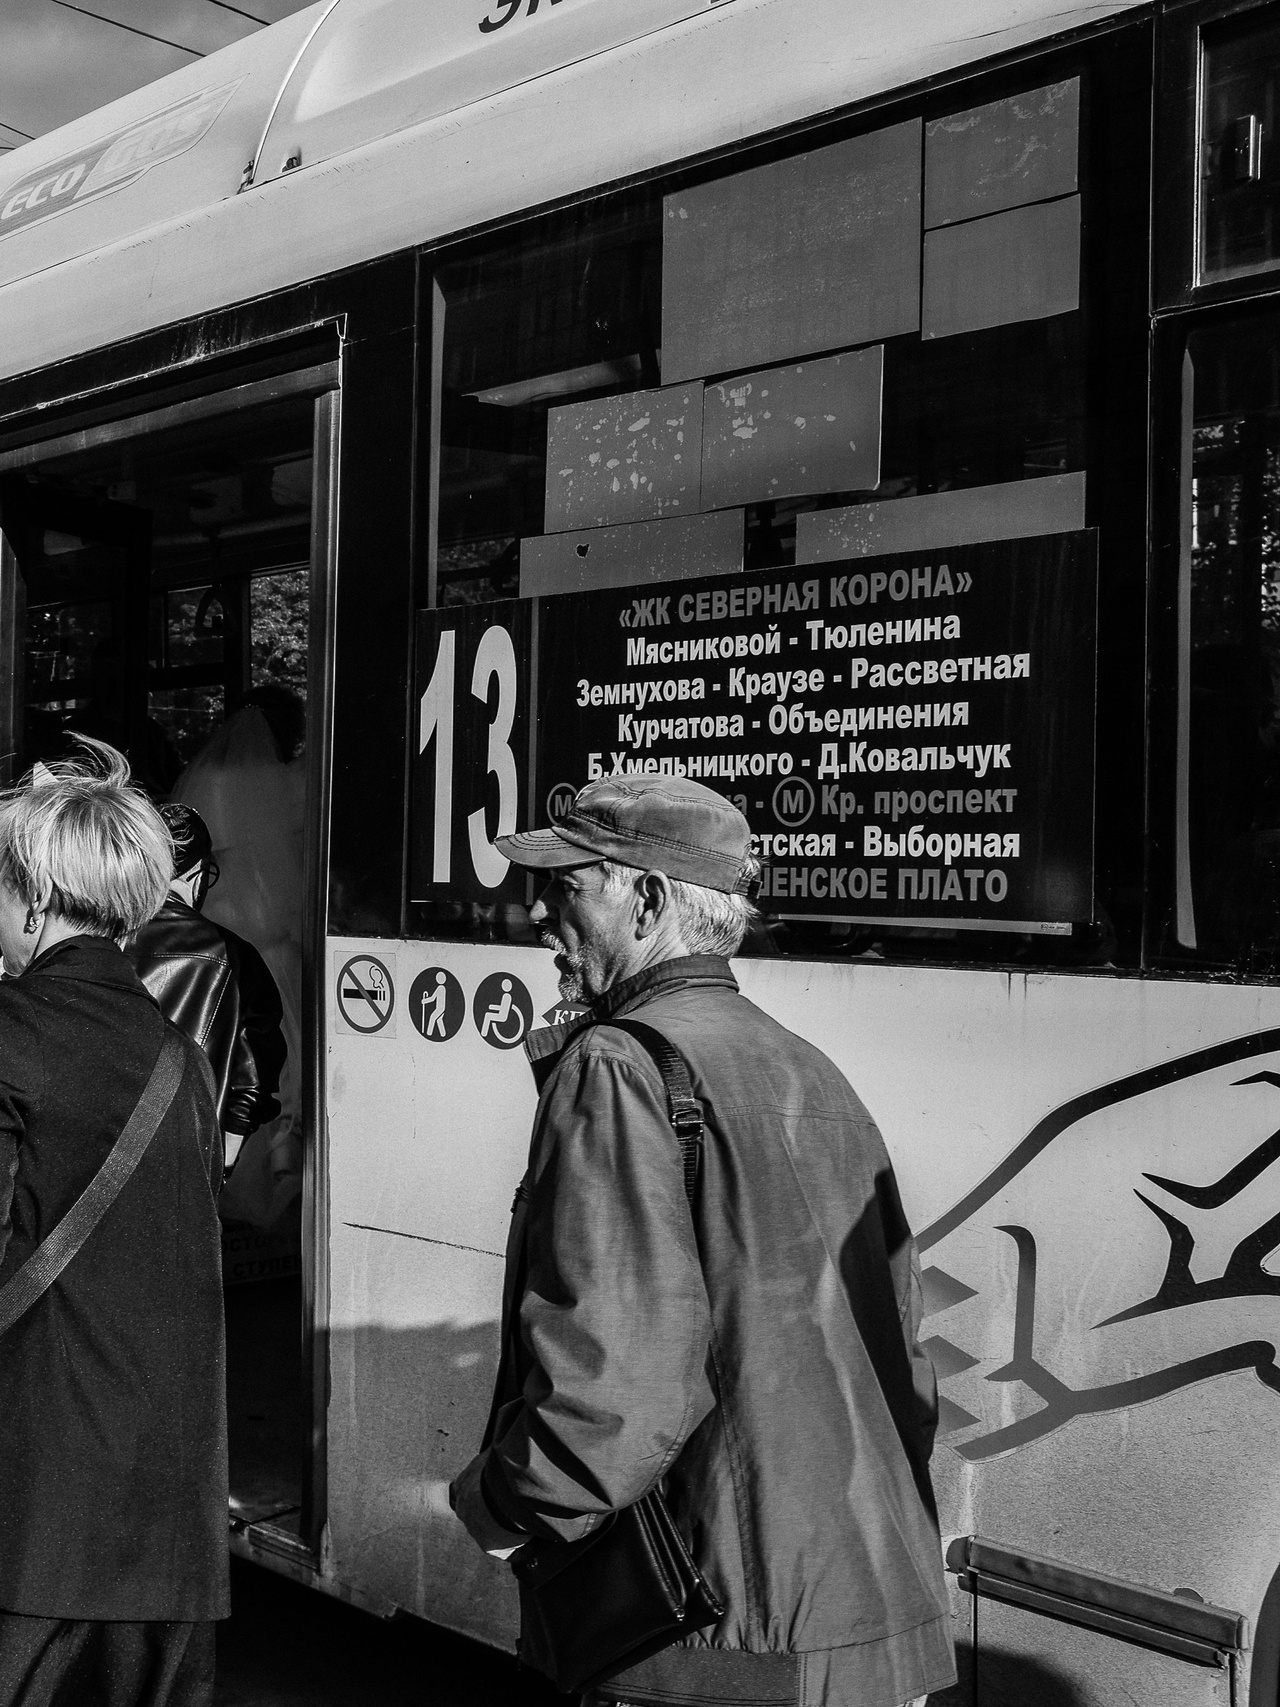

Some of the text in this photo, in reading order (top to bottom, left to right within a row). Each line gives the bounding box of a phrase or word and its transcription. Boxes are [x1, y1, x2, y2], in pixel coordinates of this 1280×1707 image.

[1, 164, 86, 220] ECO
[679, 580, 819, 622] СЕВЕРНАЯ
[831, 565, 972, 607] КОРОНА»
[627, 624, 780, 666] Мясниковой
[806, 615, 960, 650] Тюленина
[576, 678, 705, 710] Земнухова
[729, 667, 824, 703] Краузе
[851, 653, 1030, 689] Рассветная
[618, 714, 744, 748] Курчатова
[769, 702, 969, 737] Объединения
[419, 625, 518, 888] 13
[818, 741, 1011, 779] Д.Ковальчук
[822, 785, 863, 822] Кр.
[875, 789, 1017, 822] проспект
[864, 825, 1020, 865] Выборная
[898, 869, 1007, 902] ПЛАТО
